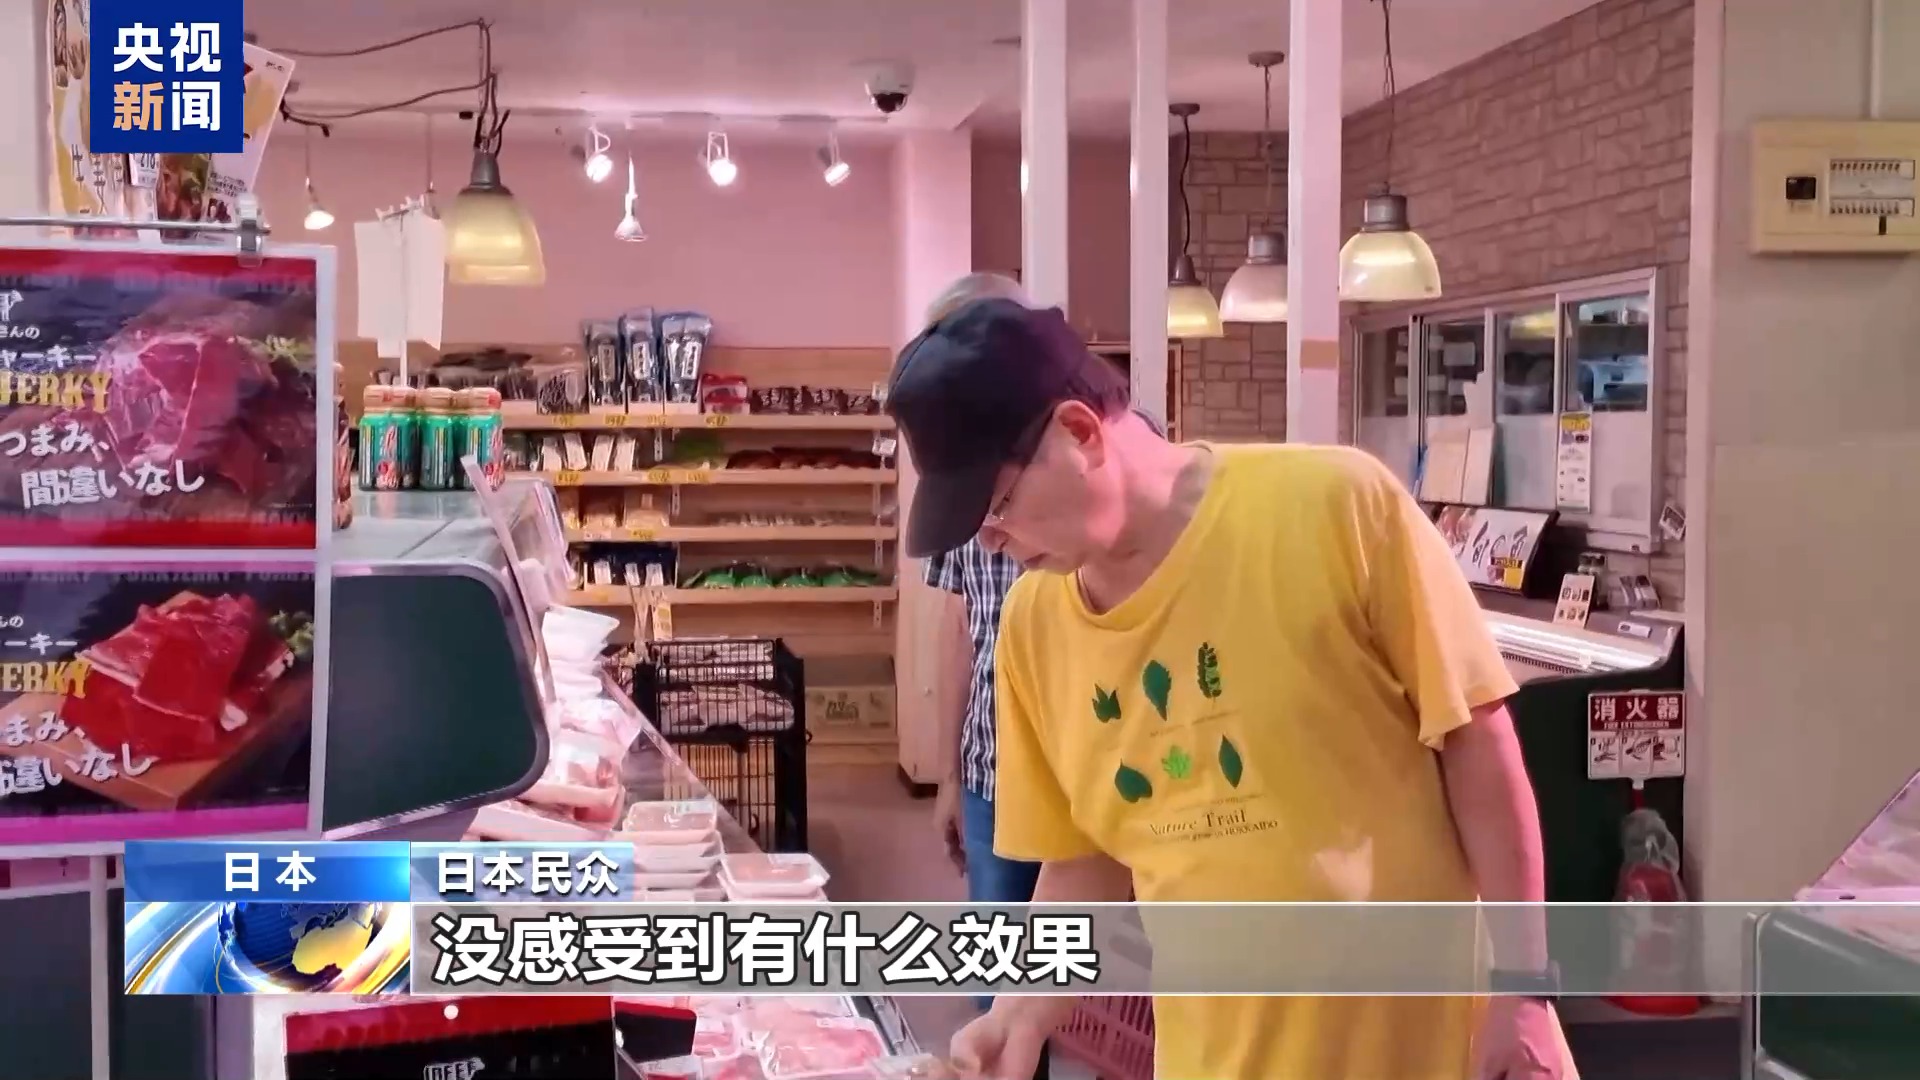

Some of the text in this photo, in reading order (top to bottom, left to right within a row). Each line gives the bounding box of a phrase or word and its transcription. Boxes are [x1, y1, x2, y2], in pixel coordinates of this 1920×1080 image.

[20, 459, 206, 509] 間違いなし
[1594, 697, 1679, 721] 消火器
[1203, 808, 1247, 828] Trail
